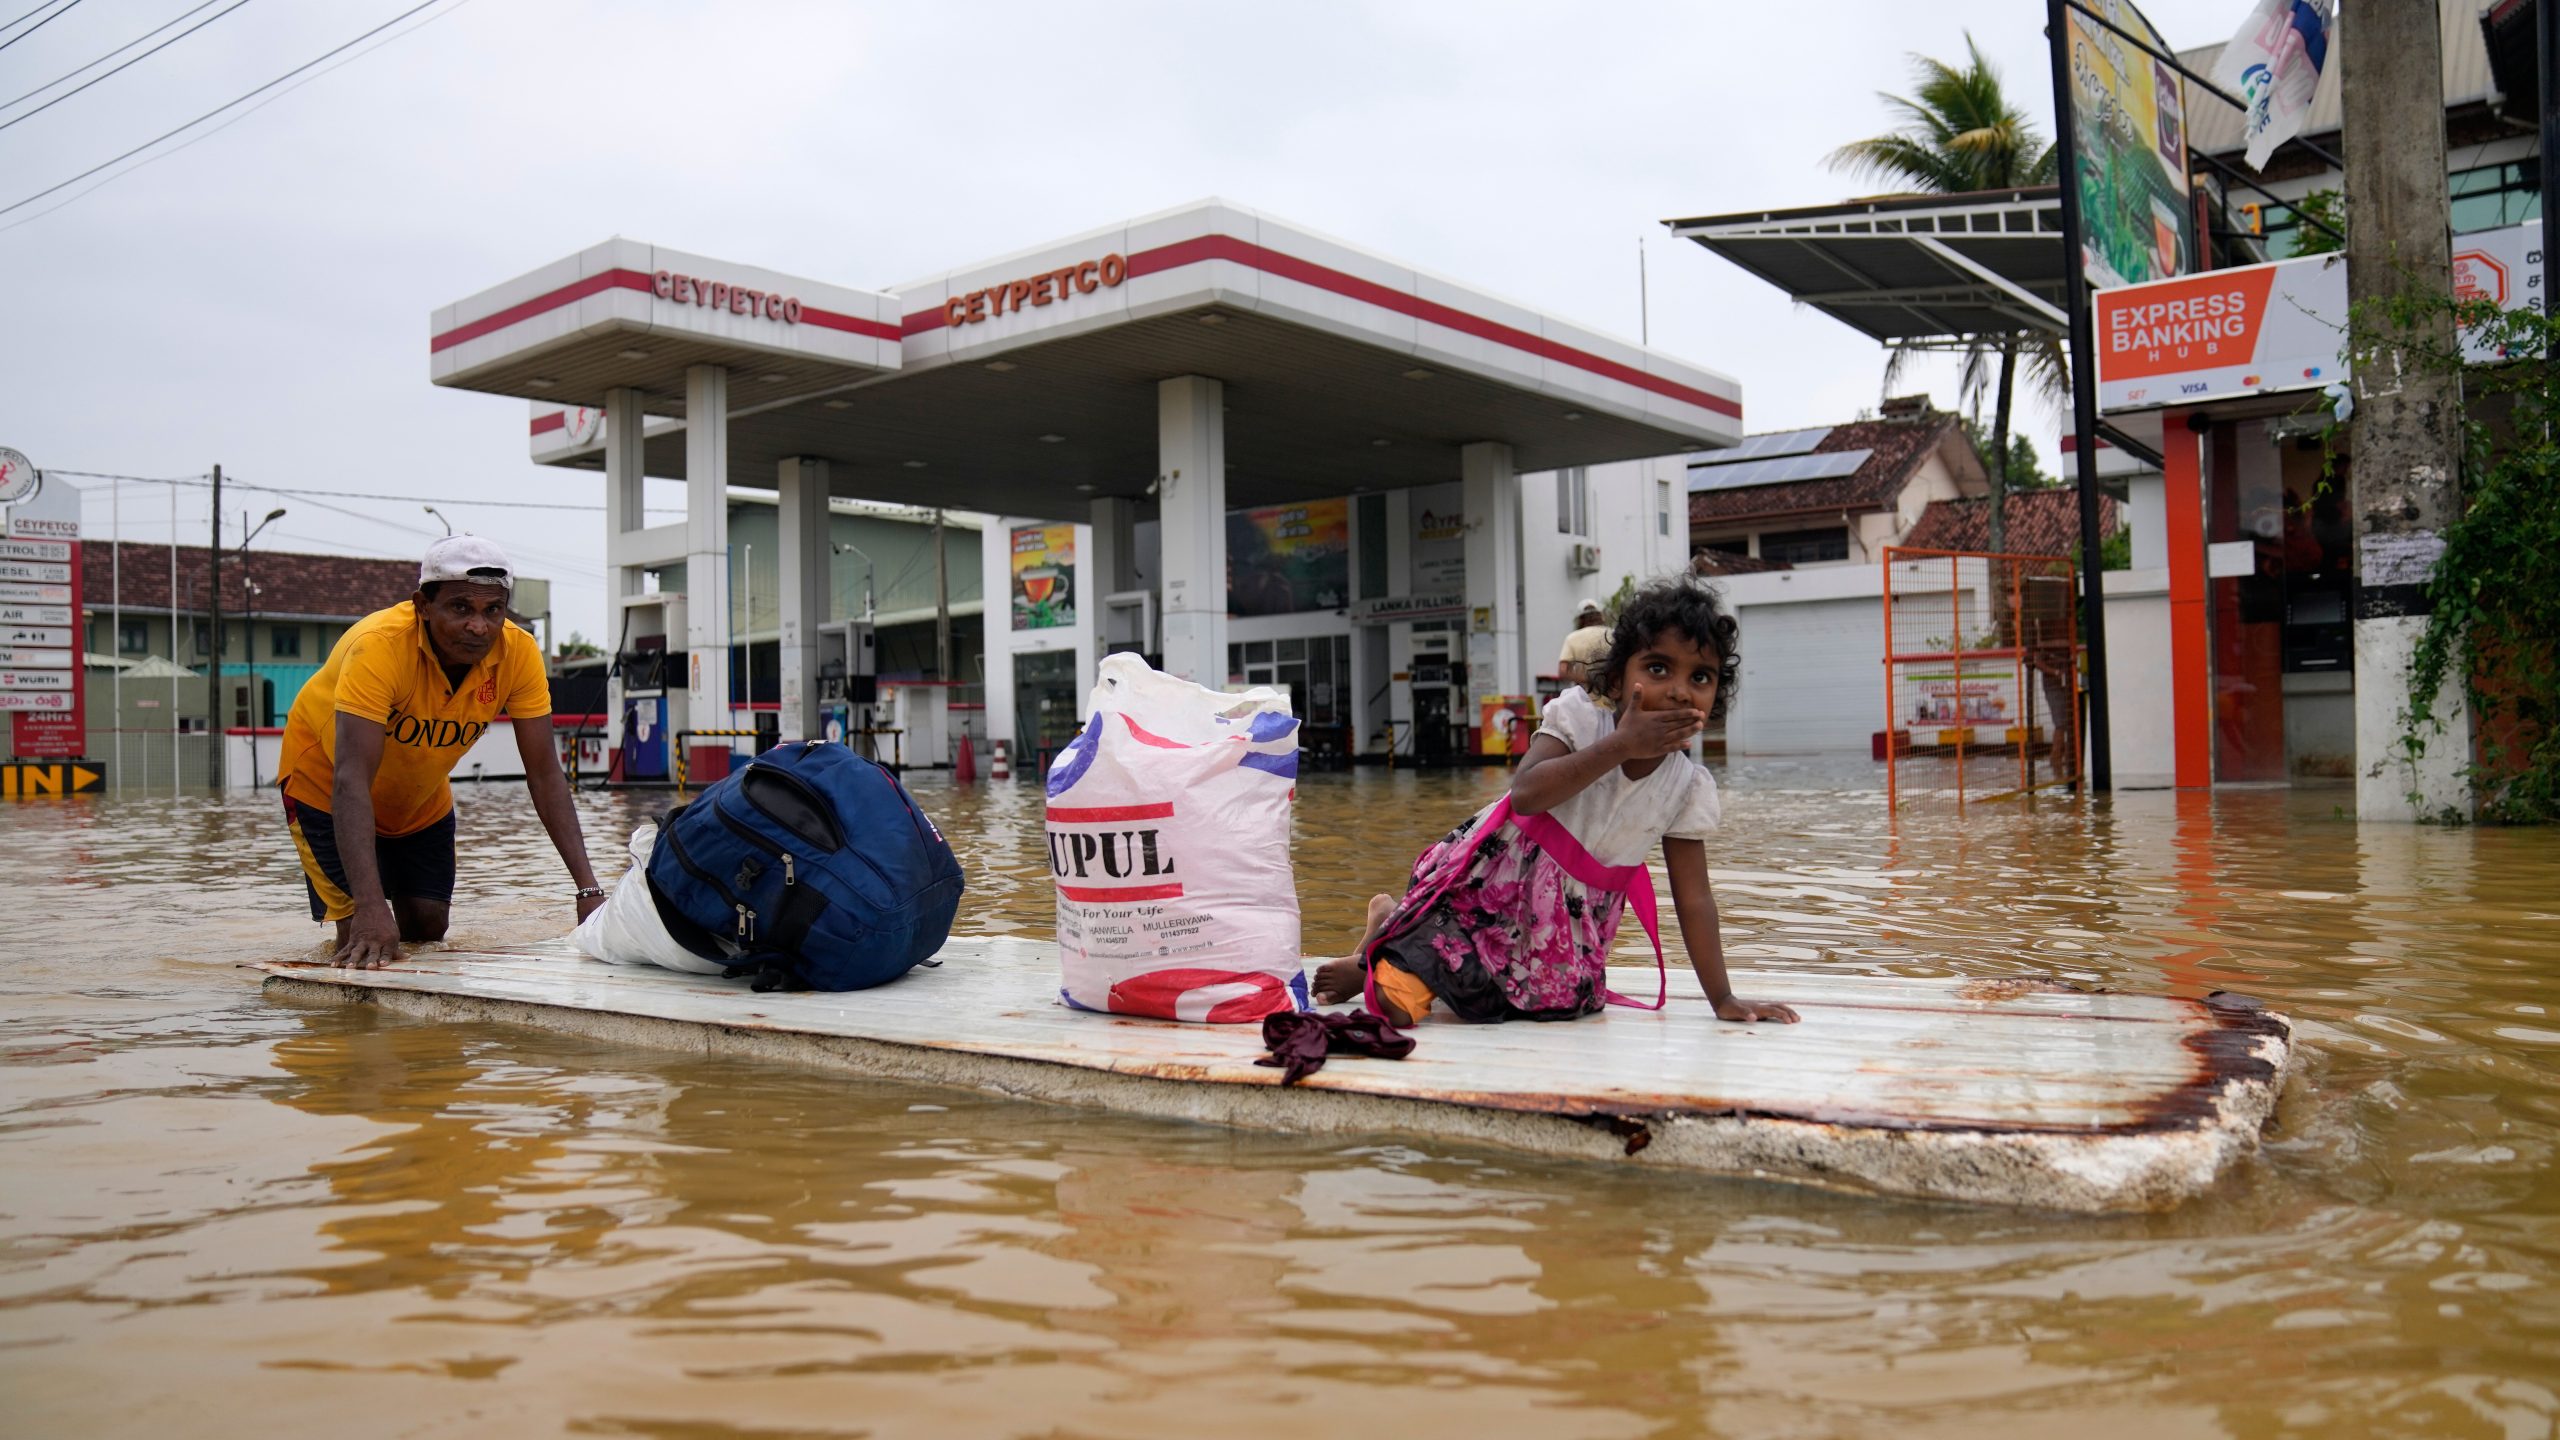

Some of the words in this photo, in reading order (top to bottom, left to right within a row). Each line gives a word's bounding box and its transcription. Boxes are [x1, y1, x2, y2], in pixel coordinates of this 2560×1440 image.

[652, 270, 802, 324] CEYPETCO
[943, 252, 1126, 329] CEYPETCO
[2111, 291, 2246, 331] EXPRESS
[2112, 315, 2245, 353] BANKING
[2181, 382, 2208, 394] VISA
[14, 518, 78, 531] CEYPETCO
[0, 544, 37, 556] ETROL
[1372, 599, 1412, 613] LANKA
[1416, 595, 1463, 609] FILLING
[3, 610, 23, 619] AIR
[0, 653, 12, 661] TM
[3, 765, 63, 794] IN
[1046, 829, 1175, 878] UPUL
[1083, 908, 1101, 920] For
[1103, 909, 1133, 919] Your
[1137, 905, 1164, 917] Life
[1089, 925, 1134, 936] HANWELLA
[1143, 913, 1214, 932] MULLERIYAWA
